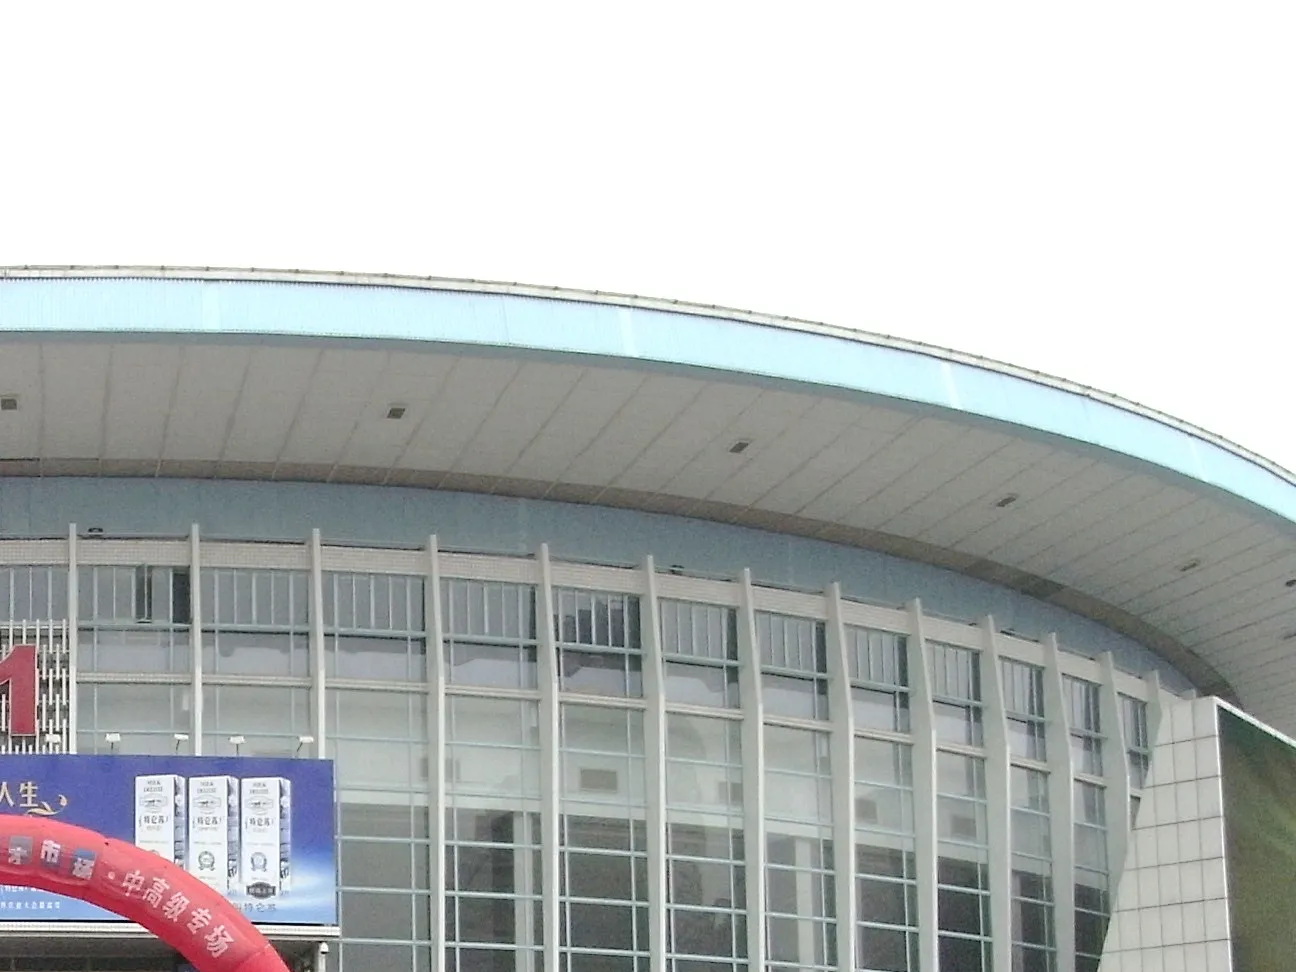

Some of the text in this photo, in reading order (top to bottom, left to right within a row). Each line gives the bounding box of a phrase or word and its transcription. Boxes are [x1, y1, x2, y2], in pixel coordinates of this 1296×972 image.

[122, 869, 235, 958] 中高级专场
